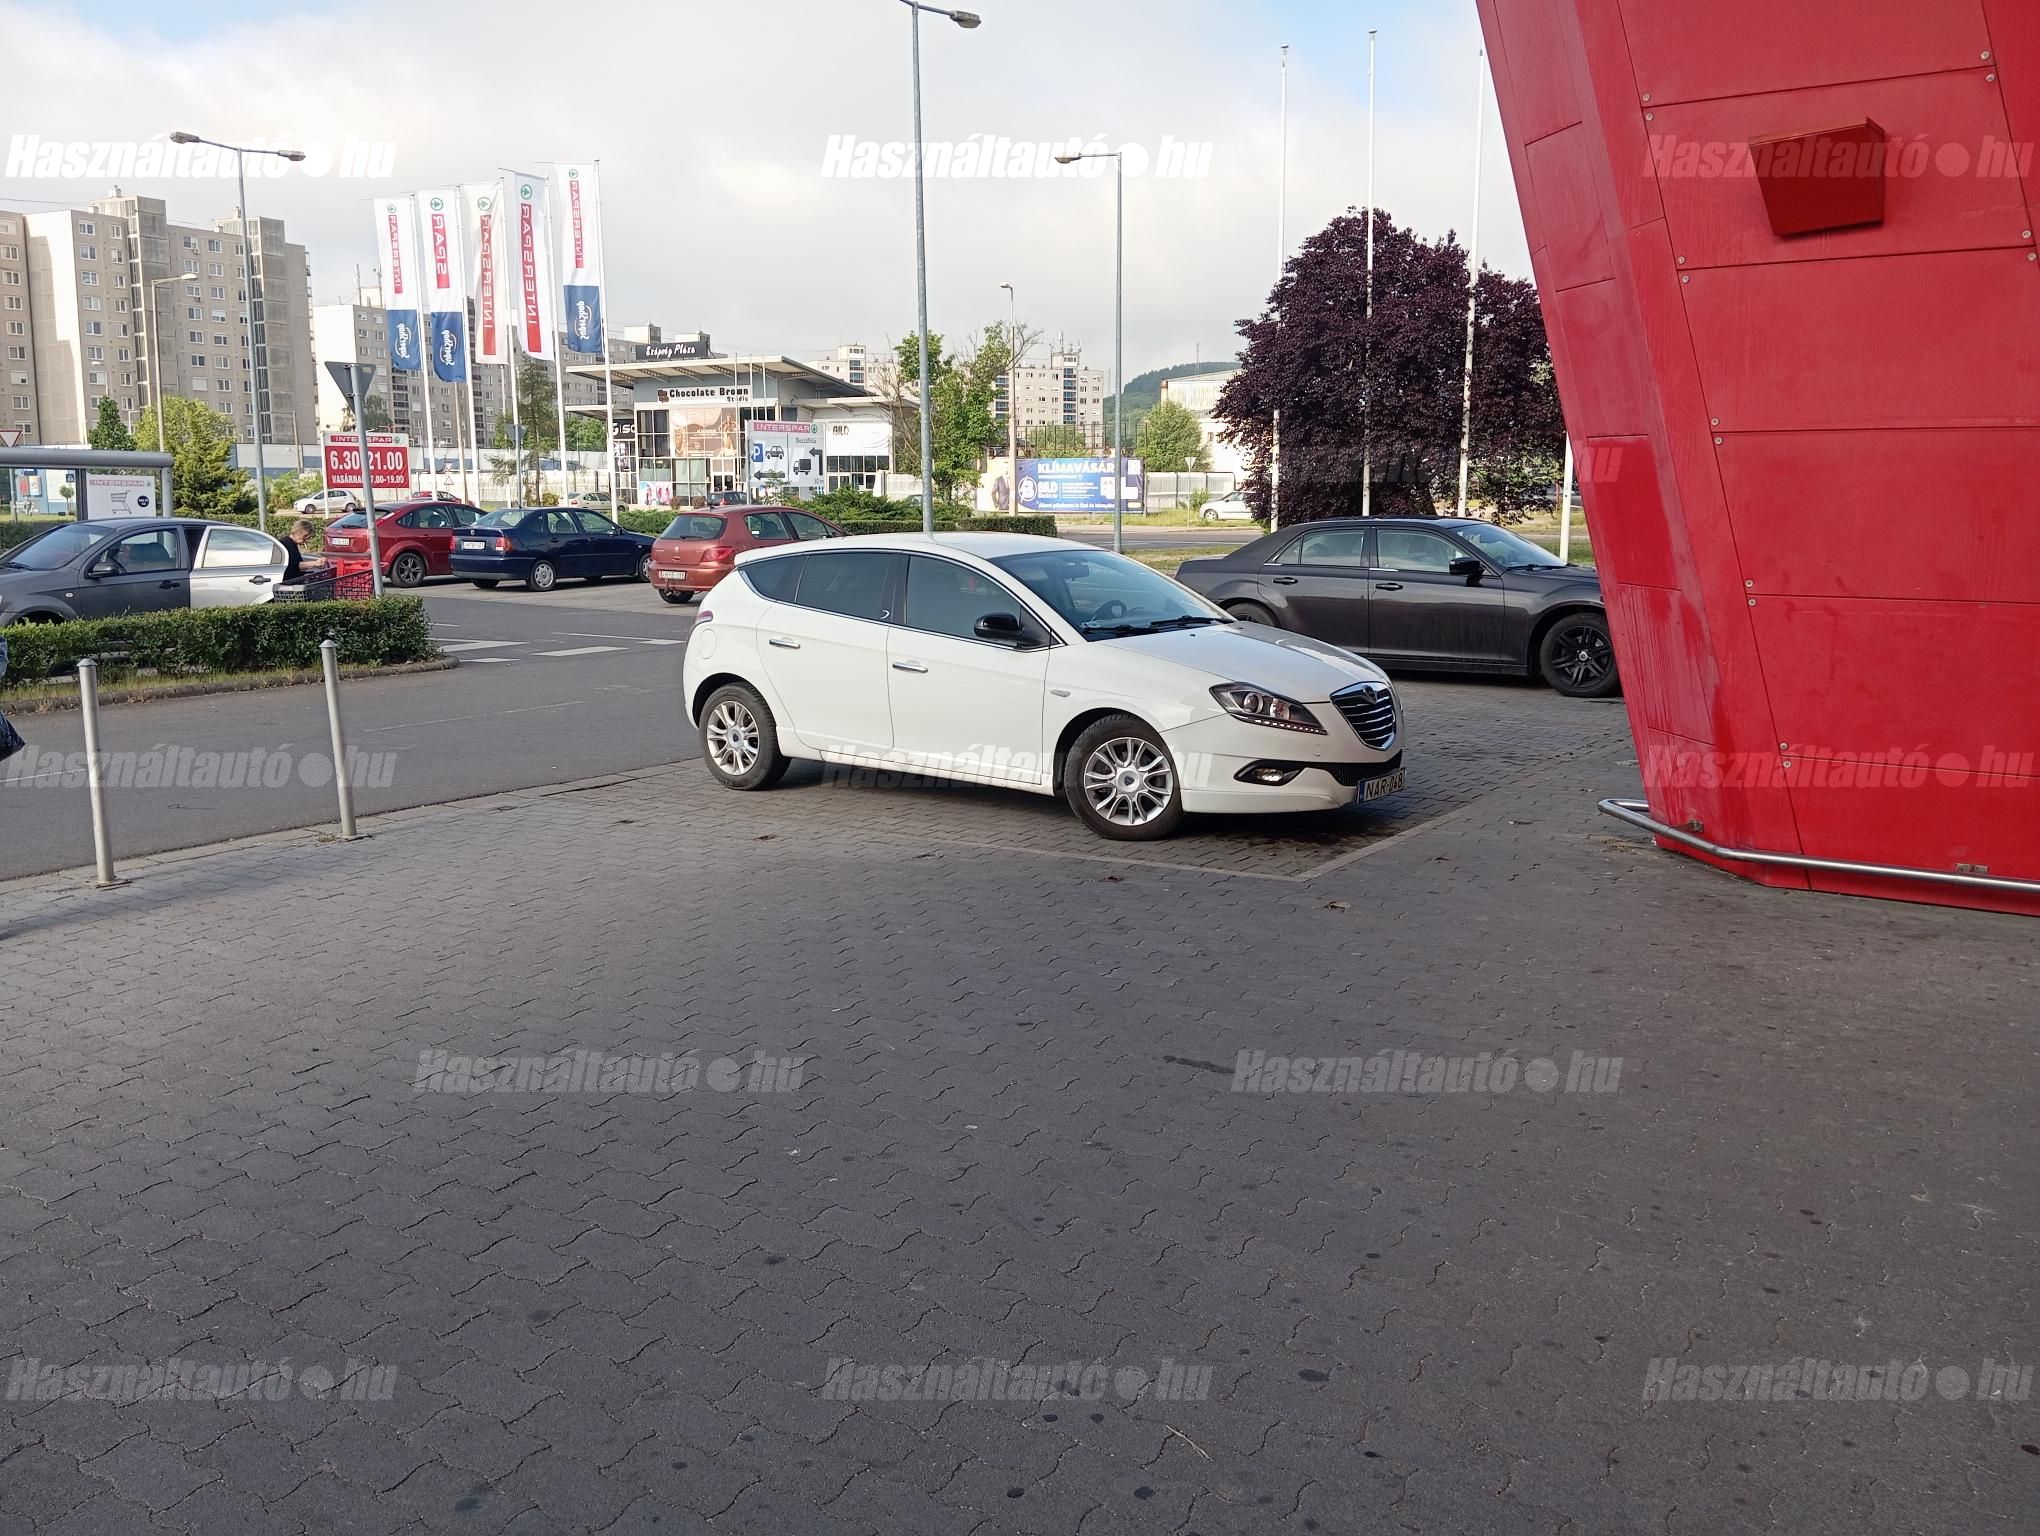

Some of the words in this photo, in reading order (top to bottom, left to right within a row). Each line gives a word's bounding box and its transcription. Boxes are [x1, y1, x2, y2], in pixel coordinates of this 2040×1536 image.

[669, 388, 715, 398] Chocolate
[719, 387, 749, 396] Brown
[756, 424, 810, 433] INTERSPAR
[335, 436, 392, 444] INTESPAR
[331, 473, 363, 484] VASÁRNA
